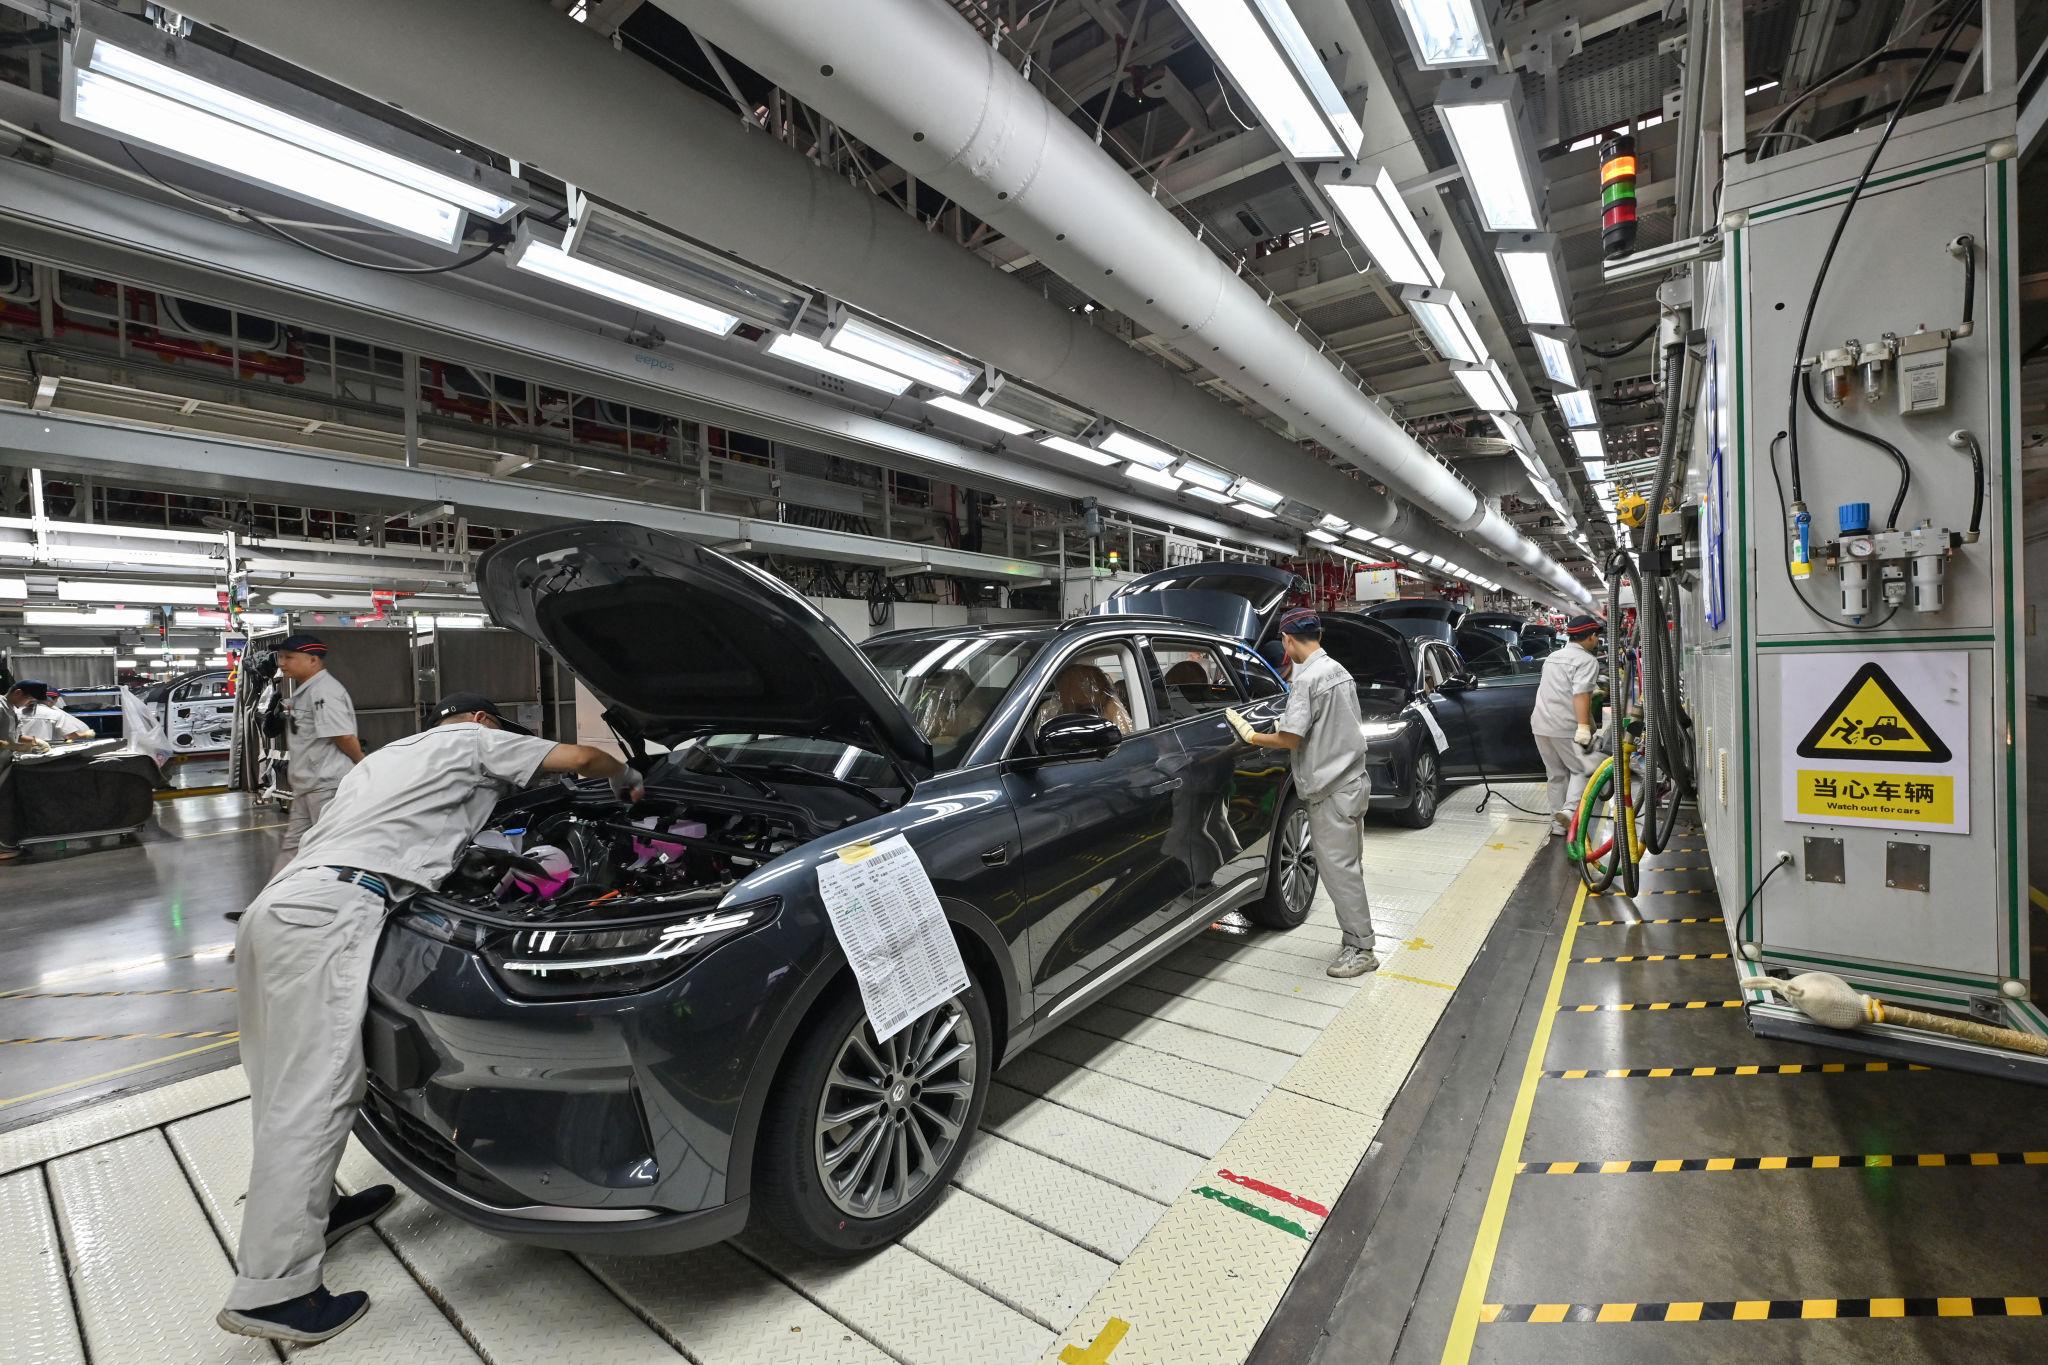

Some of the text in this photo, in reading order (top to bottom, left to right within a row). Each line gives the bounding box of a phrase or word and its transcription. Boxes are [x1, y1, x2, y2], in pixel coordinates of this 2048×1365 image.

[635, 352, 674, 371] eepos
[1813, 777, 1935, 804] 当心车辆
[1827, 802, 1858, 811] Watch
[1880, 805, 1895, 813] for
